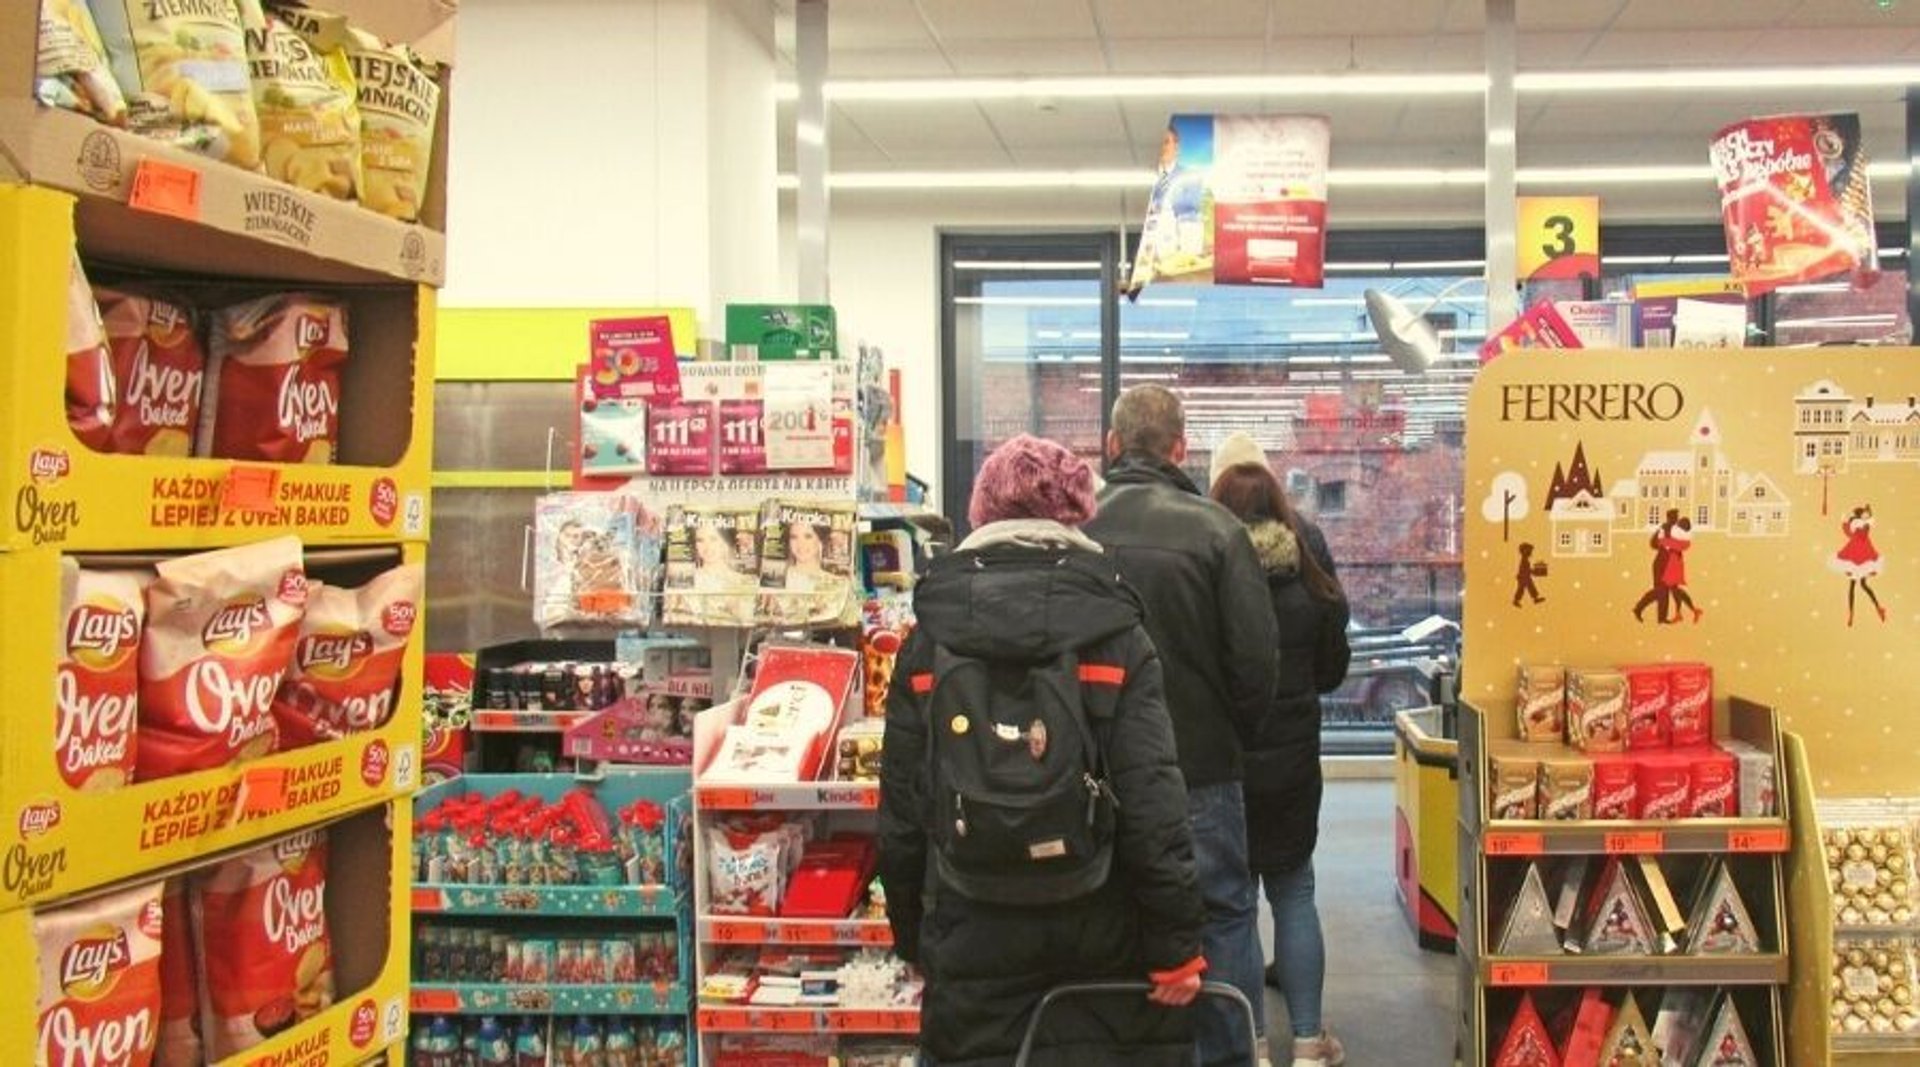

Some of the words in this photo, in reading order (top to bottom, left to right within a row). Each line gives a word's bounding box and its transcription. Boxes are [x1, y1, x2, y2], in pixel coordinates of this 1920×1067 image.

[352, 53, 435, 107] IEJSKIE
[244, 192, 316, 232] WIEJSKIE
[245, 214, 311, 247] ZIEMNIACZKI
[1542, 215, 1576, 260] 3
[1500, 383, 1684, 422] FERRERO
[33, 451, 68, 479] Lay's
[152, 474, 220, 499] KAŻDY
[280, 482, 351, 502] SMAKUJE
[15, 485, 80, 533] Oven
[150, 504, 219, 527] LEPIEJ
[295, 506, 350, 527] BAKED
[70, 606, 136, 657] Lay's
[204, 600, 268, 643] Lay's
[302, 630, 370, 670] Lay's
[65, 733, 128, 773] Baked
[21, 804, 60, 836] Lay's
[139, 813, 211, 850] LEPIEJ
[213, 808, 228, 830] Z
[287, 780, 342, 810] BAKED
[142, 786, 213, 824] KAŻDY
[3, 843, 67, 892] Oven
[62, 932, 126, 988] Lay's
[36, 1006, 154, 1067] Oven
